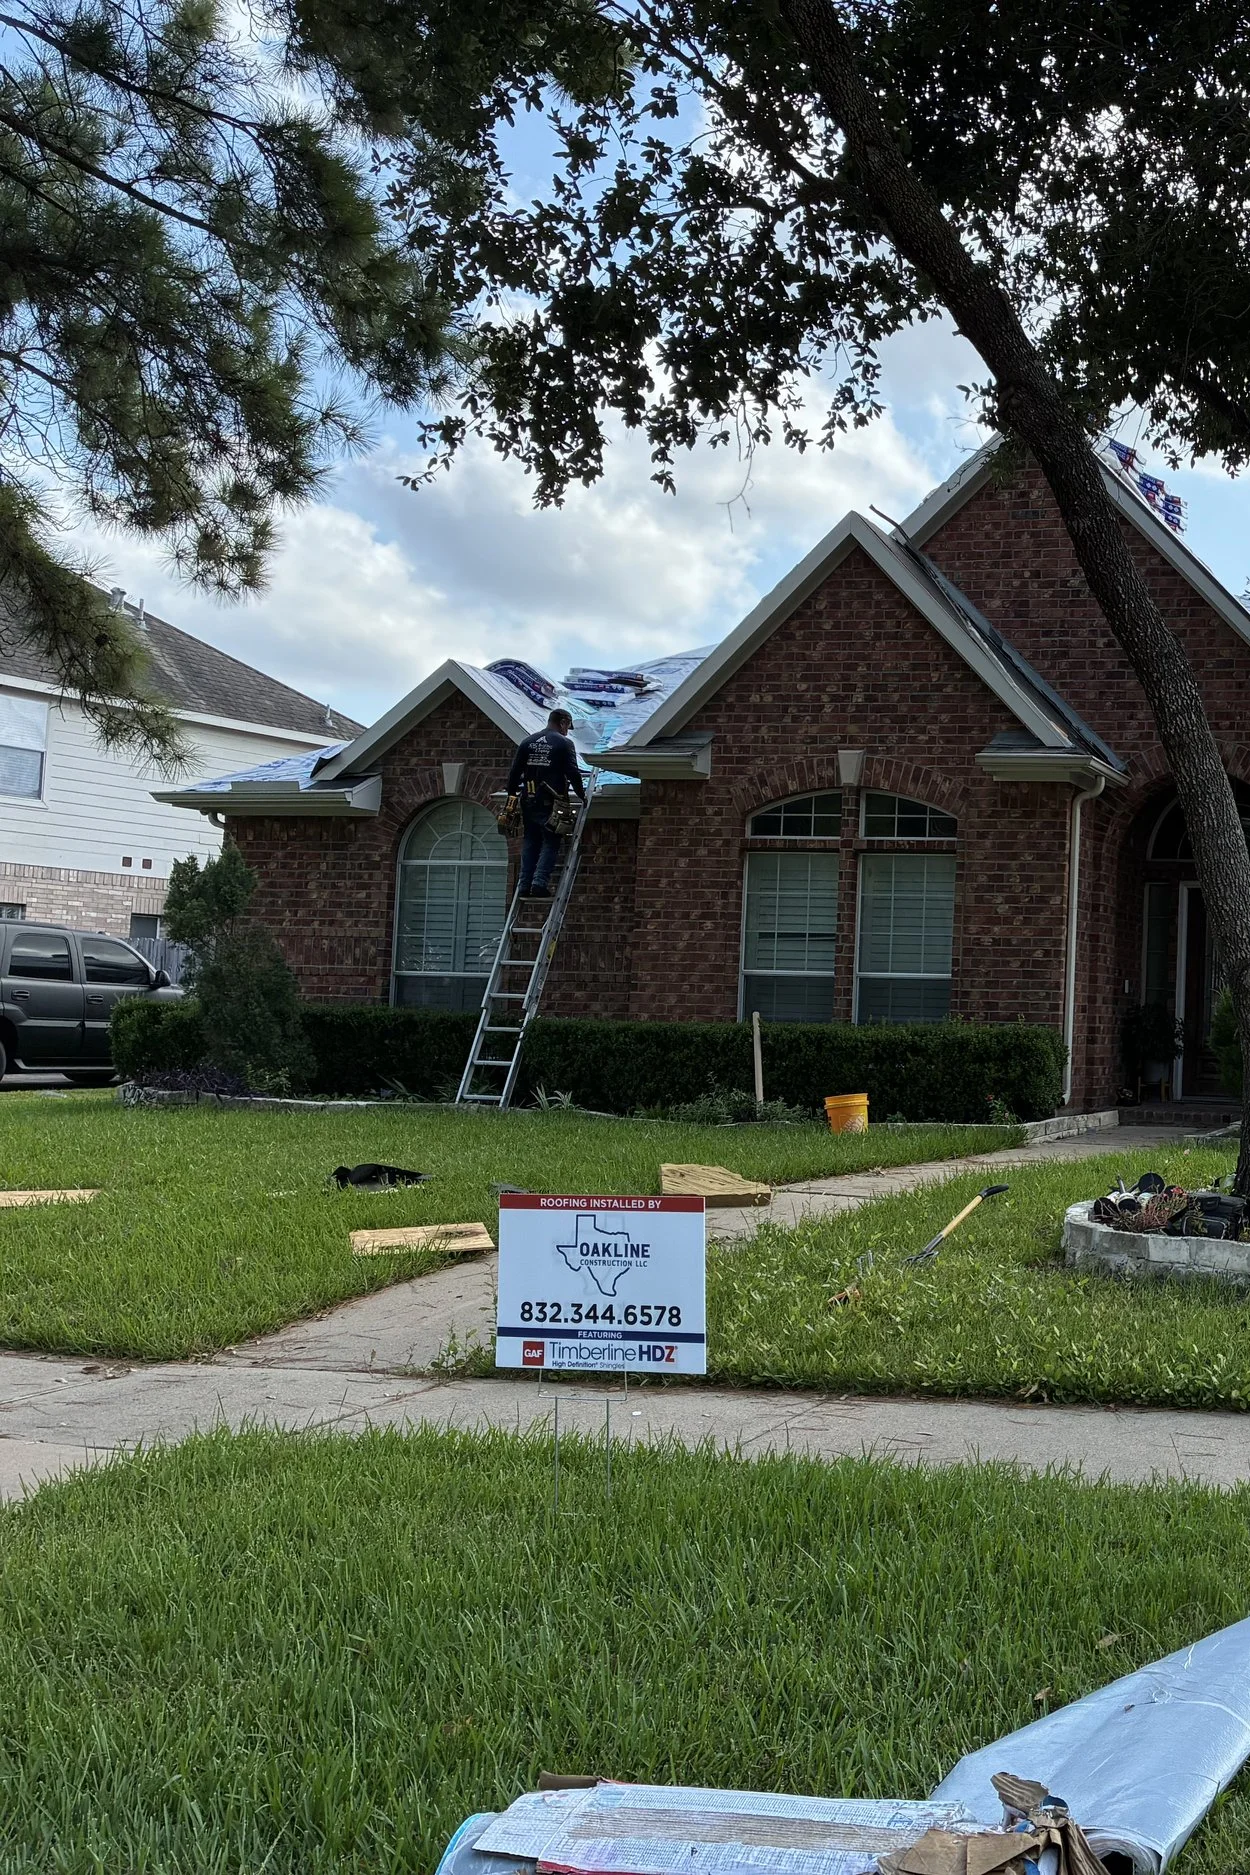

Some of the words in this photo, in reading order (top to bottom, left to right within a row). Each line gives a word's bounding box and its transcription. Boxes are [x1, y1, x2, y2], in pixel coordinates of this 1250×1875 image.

[540, 1198, 587, 1208] ROOFING
[590, 1199, 645, 1209] INSTALLED
[648, 1200, 662, 1209] BY
[579, 1242, 651, 1258] OAKLINE
[580, 1259, 633, 1267] CONSTRUCTION
[635, 1260, 648, 1268] LLC
[520, 1301, 682, 1327] 832.344.6578
[577, 1330, 623, 1339] FEATURING
[524, 1348, 544, 1358] GAF
[552, 1360, 566, 1369] High
[599, 1361, 626, 1370] Shingles
